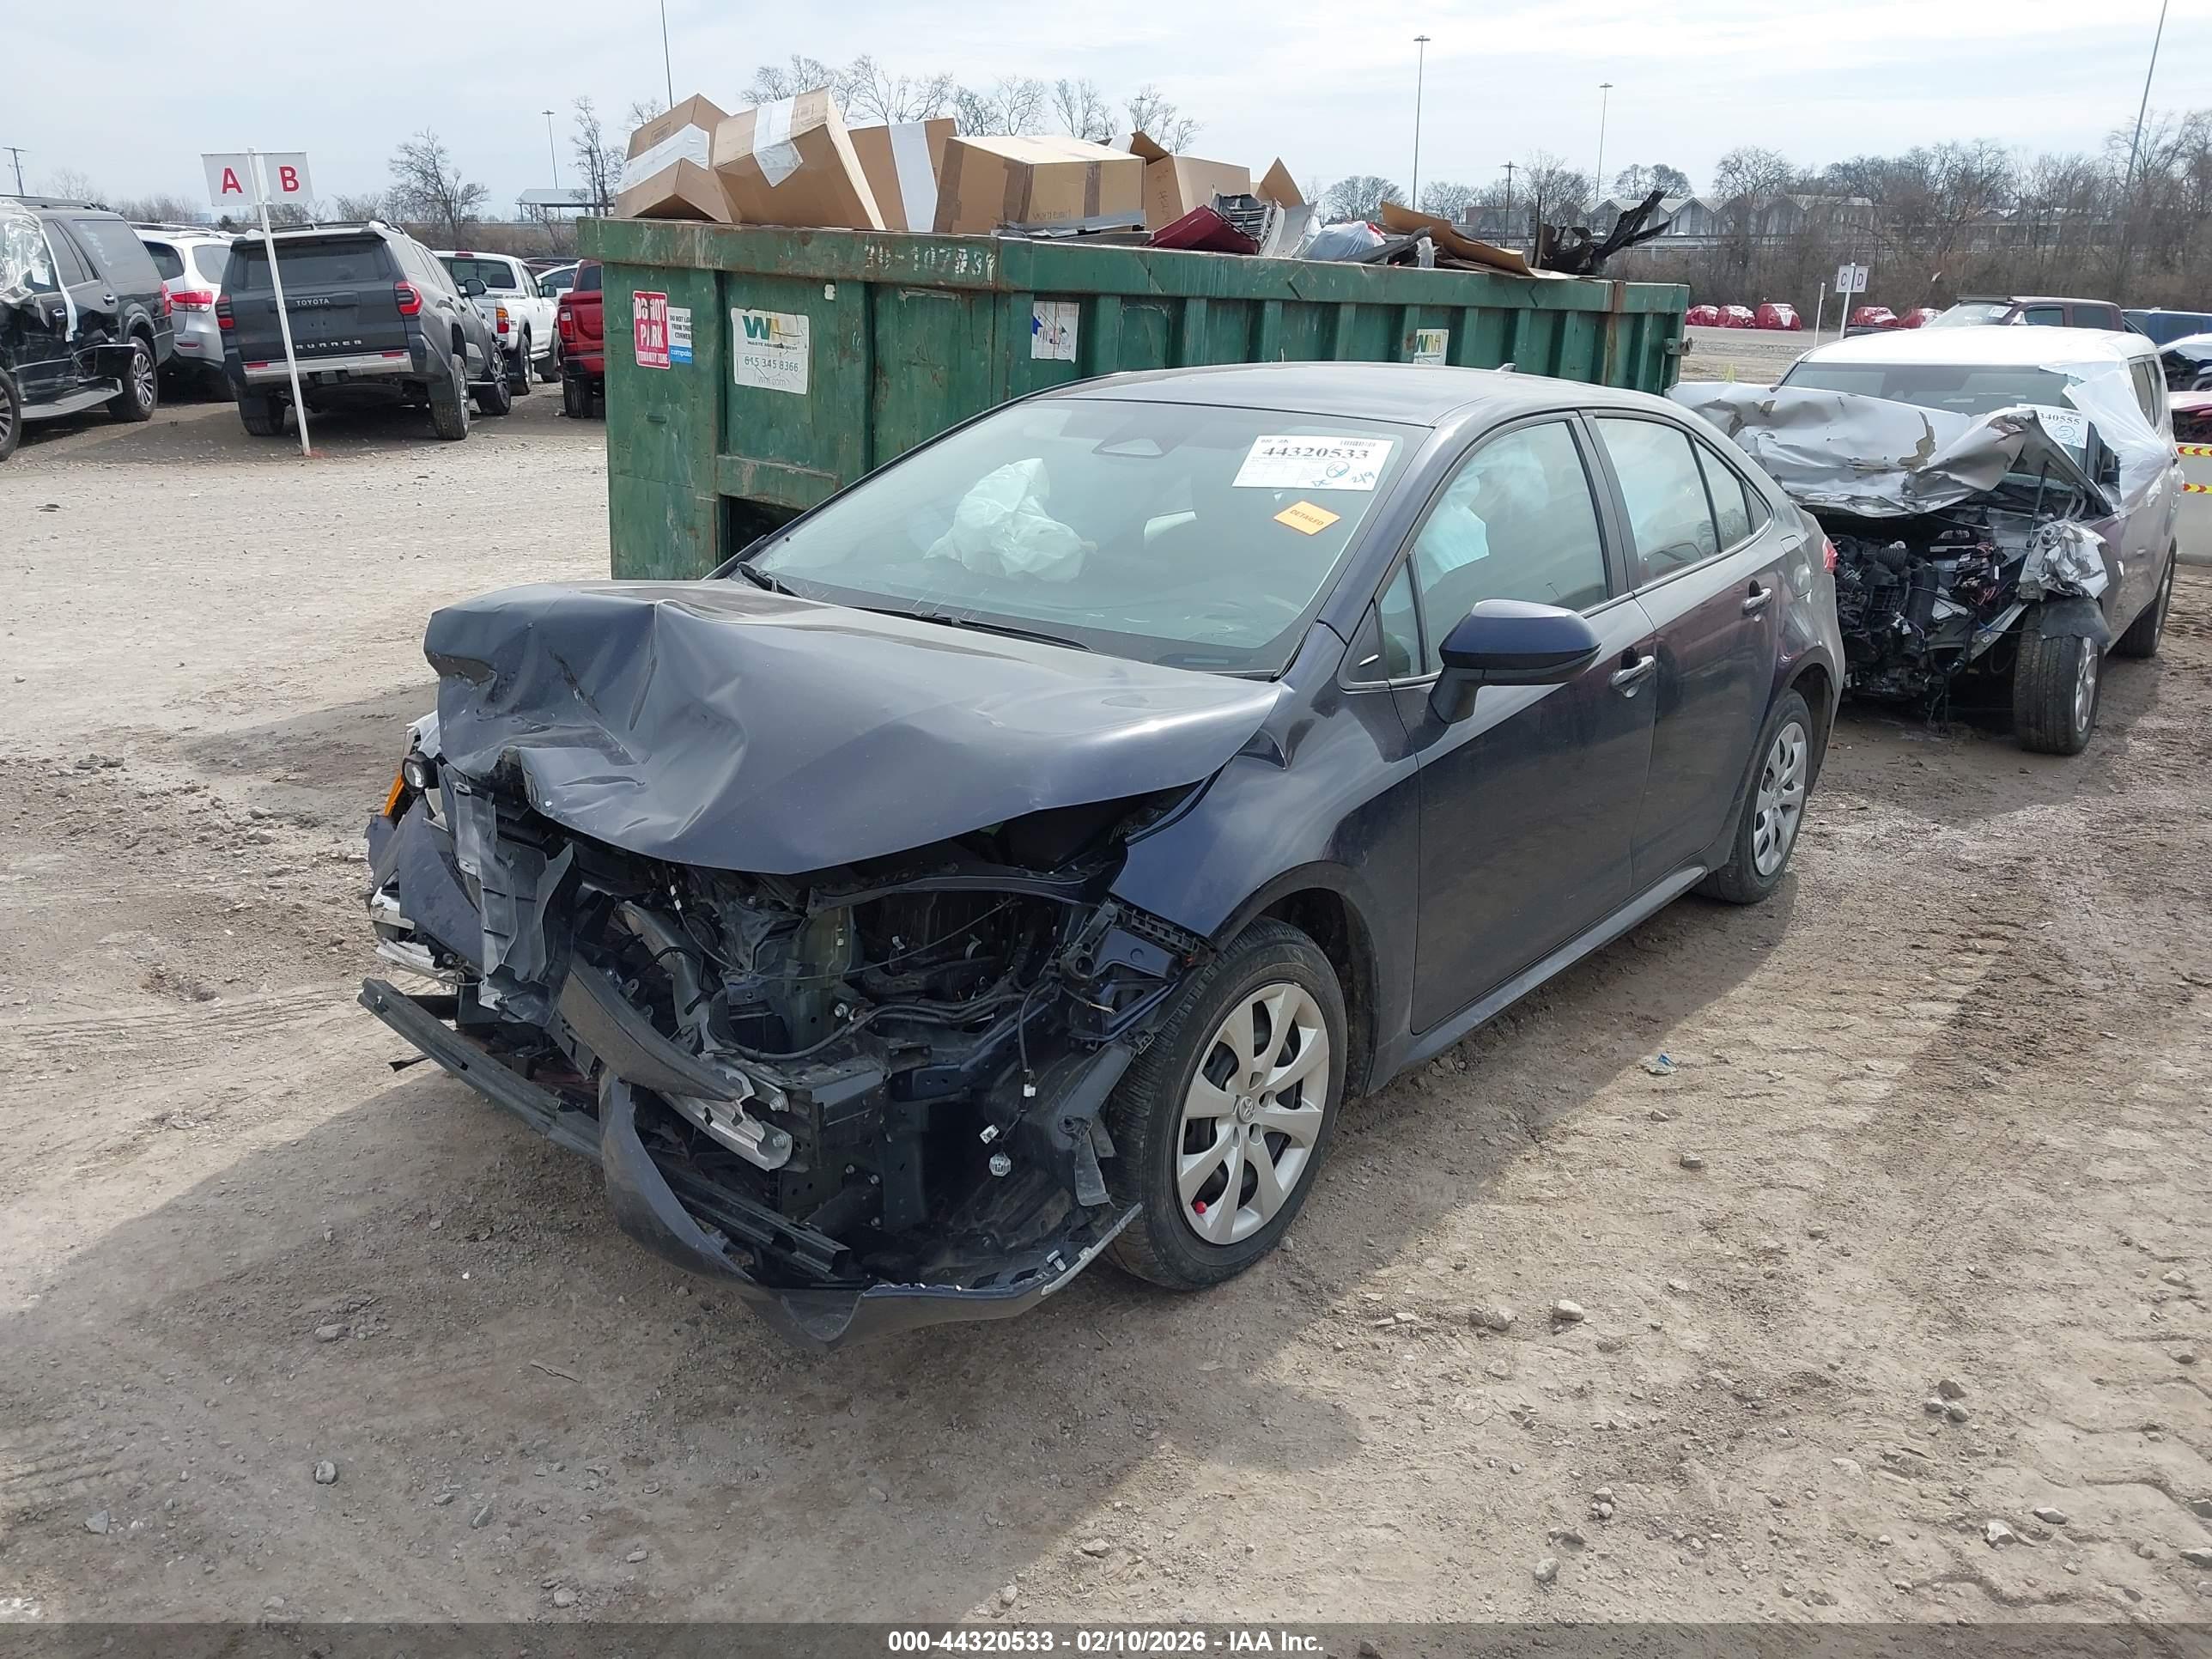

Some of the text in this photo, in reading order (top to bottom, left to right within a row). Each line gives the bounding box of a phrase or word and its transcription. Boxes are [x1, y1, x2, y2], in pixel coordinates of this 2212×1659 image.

[222, 167, 244, 194] A
[278, 166, 300, 192] B
[1840, 272, 1847, 287] C
[1856, 272, 1864, 287] D
[295, 298, 331, 307] TOYOTA
[635, 297, 665, 322] DO NOT
[639, 324, 664, 349] PARK
[763, 342, 798, 351] MANAMENT
[744, 356, 799, 372] 615 345 8366
[1261, 447, 1370, 459] 44320533
[1290, 509, 1324, 526] DETAILED
